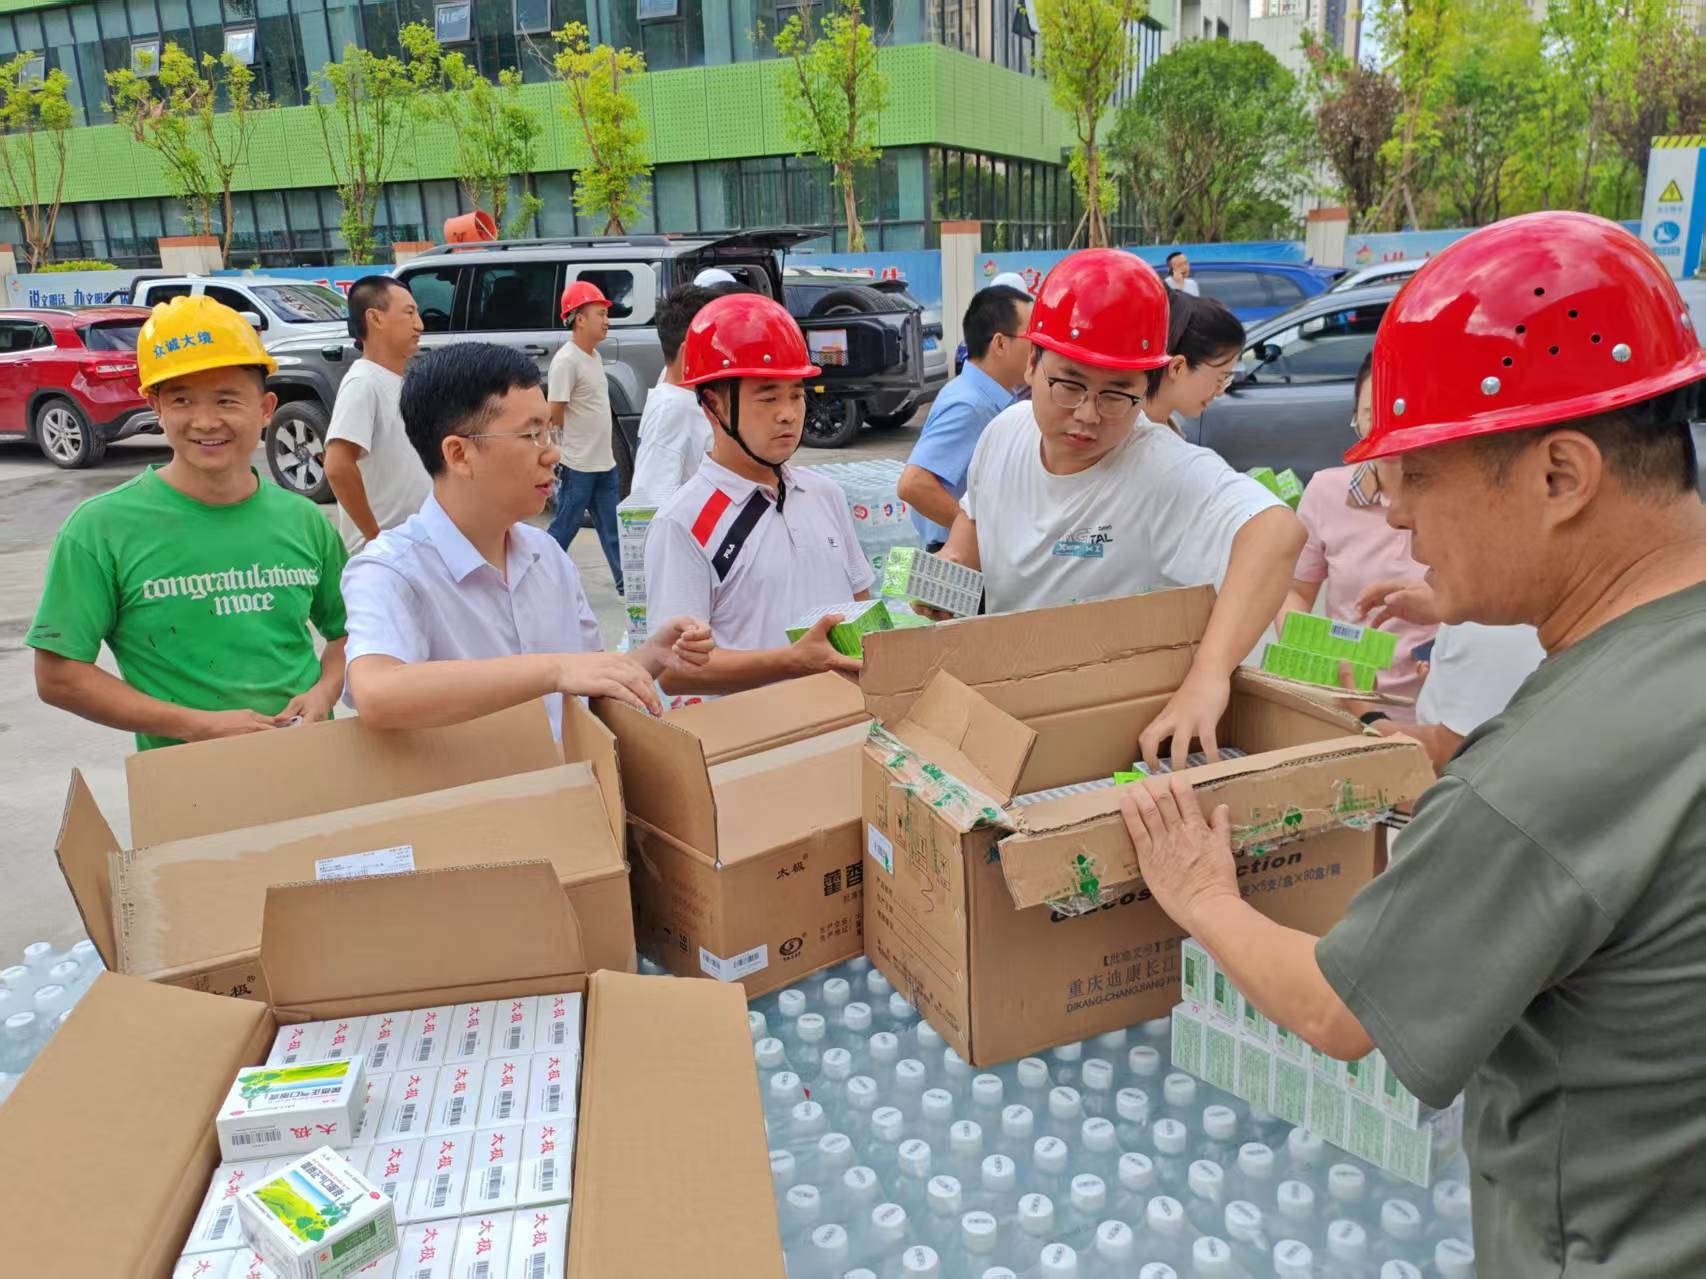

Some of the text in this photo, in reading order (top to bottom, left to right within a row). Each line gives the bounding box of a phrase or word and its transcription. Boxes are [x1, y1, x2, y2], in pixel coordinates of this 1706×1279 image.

[723, 544, 735, 559] FILA
[143, 562, 320, 600] congratulations
[1236, 851, 1303, 877] ction
[423, 1012, 438, 1034] 太极
[453, 1069, 469, 1093] 太极
[501, 1063, 515, 1087] 太极
[548, 1057, 561, 1081] 太极
[404, 1075, 421, 1100] 太极
[289, 1121, 337, 1140] 太极
[540, 1126, 556, 1154] 太极
[437, 1141, 455, 1170] 太极
[489, 1133, 505, 1162] 太极
[384, 1148, 403, 1177] 太极
[475, 1220, 494, 1256] 太极
[532, 1213, 549, 1247] 太极
[419, 1228, 439, 1263] 太极
